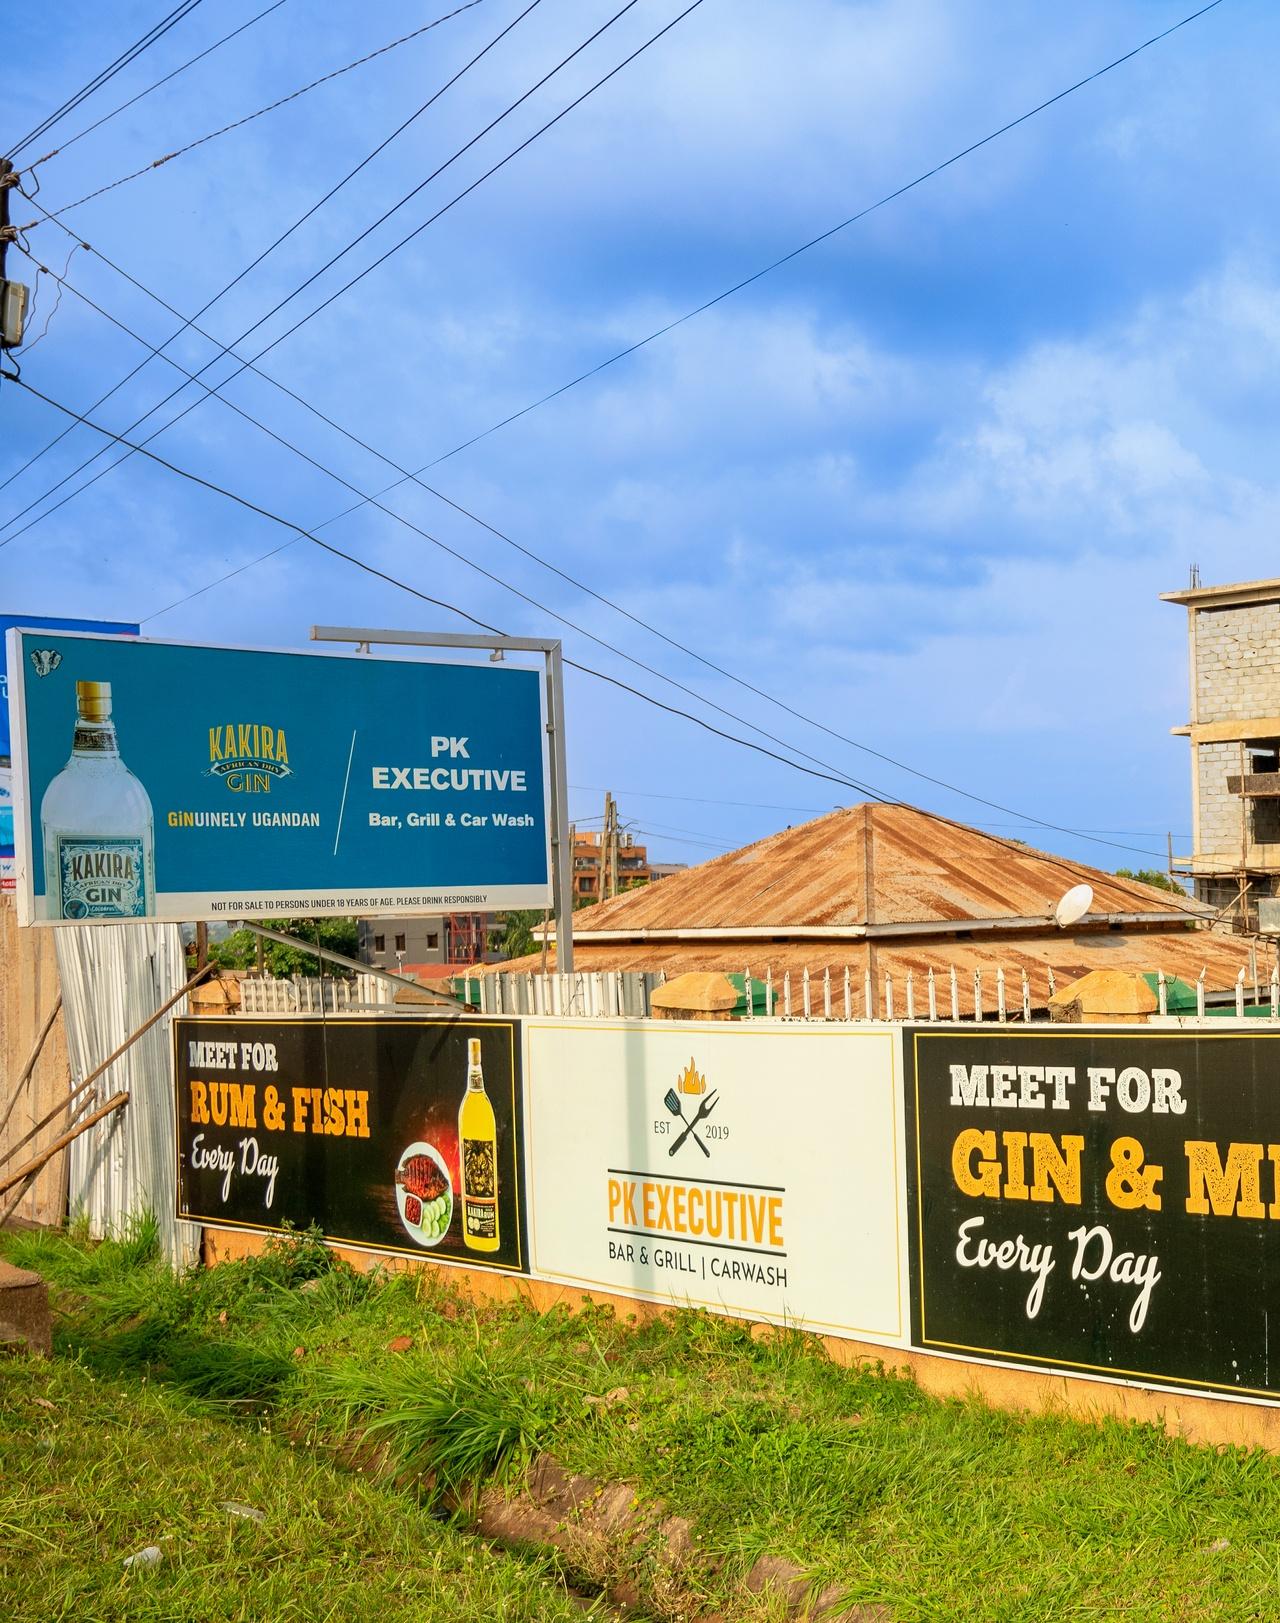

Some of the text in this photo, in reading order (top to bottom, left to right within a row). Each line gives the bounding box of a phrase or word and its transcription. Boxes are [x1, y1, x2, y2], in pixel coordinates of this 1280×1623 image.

[209, 724, 288, 764] KAKIRA
[431, 735, 470, 758] PK
[220, 761, 260, 772] AFRICAN
[372, 766, 527, 791] EXECUTIVE
[227, 773, 271, 793] GIN
[252, 812, 320, 827] UGANDAN
[368, 812, 535, 829] Bar, Grill & Car Wash
[72, 853, 134, 880] KAKIRA
[85, 888, 122, 902] GIN
[211, 895, 488, 911] NOT FOR SALE TO PERSONS UNDER 18 YEARS OF AGE. PLEASE DRINK RESPONSIBLY
[189, 1041, 279, 1072] MEET FOR
[949, 1064, 1187, 1115] MEET FOR
[190, 1081, 371, 1138] RUM & FISH
[654, 1120, 729, 1140] EST 2019
[191, 1133, 279, 1209] Every Day
[951, 1128, 1084, 1205] GIN
[1106, 1135, 1163, 1212] &
[608, 1179, 784, 1247] PK EXECUTIVE
[608, 1241, 635, 1264] BAR
[639, 1247, 650, 1265] &
[654, 1249, 697, 1273] GRILL
[710, 1258, 788, 1288] CARWASH
[955, 1216, 1162, 1334] Every Day
